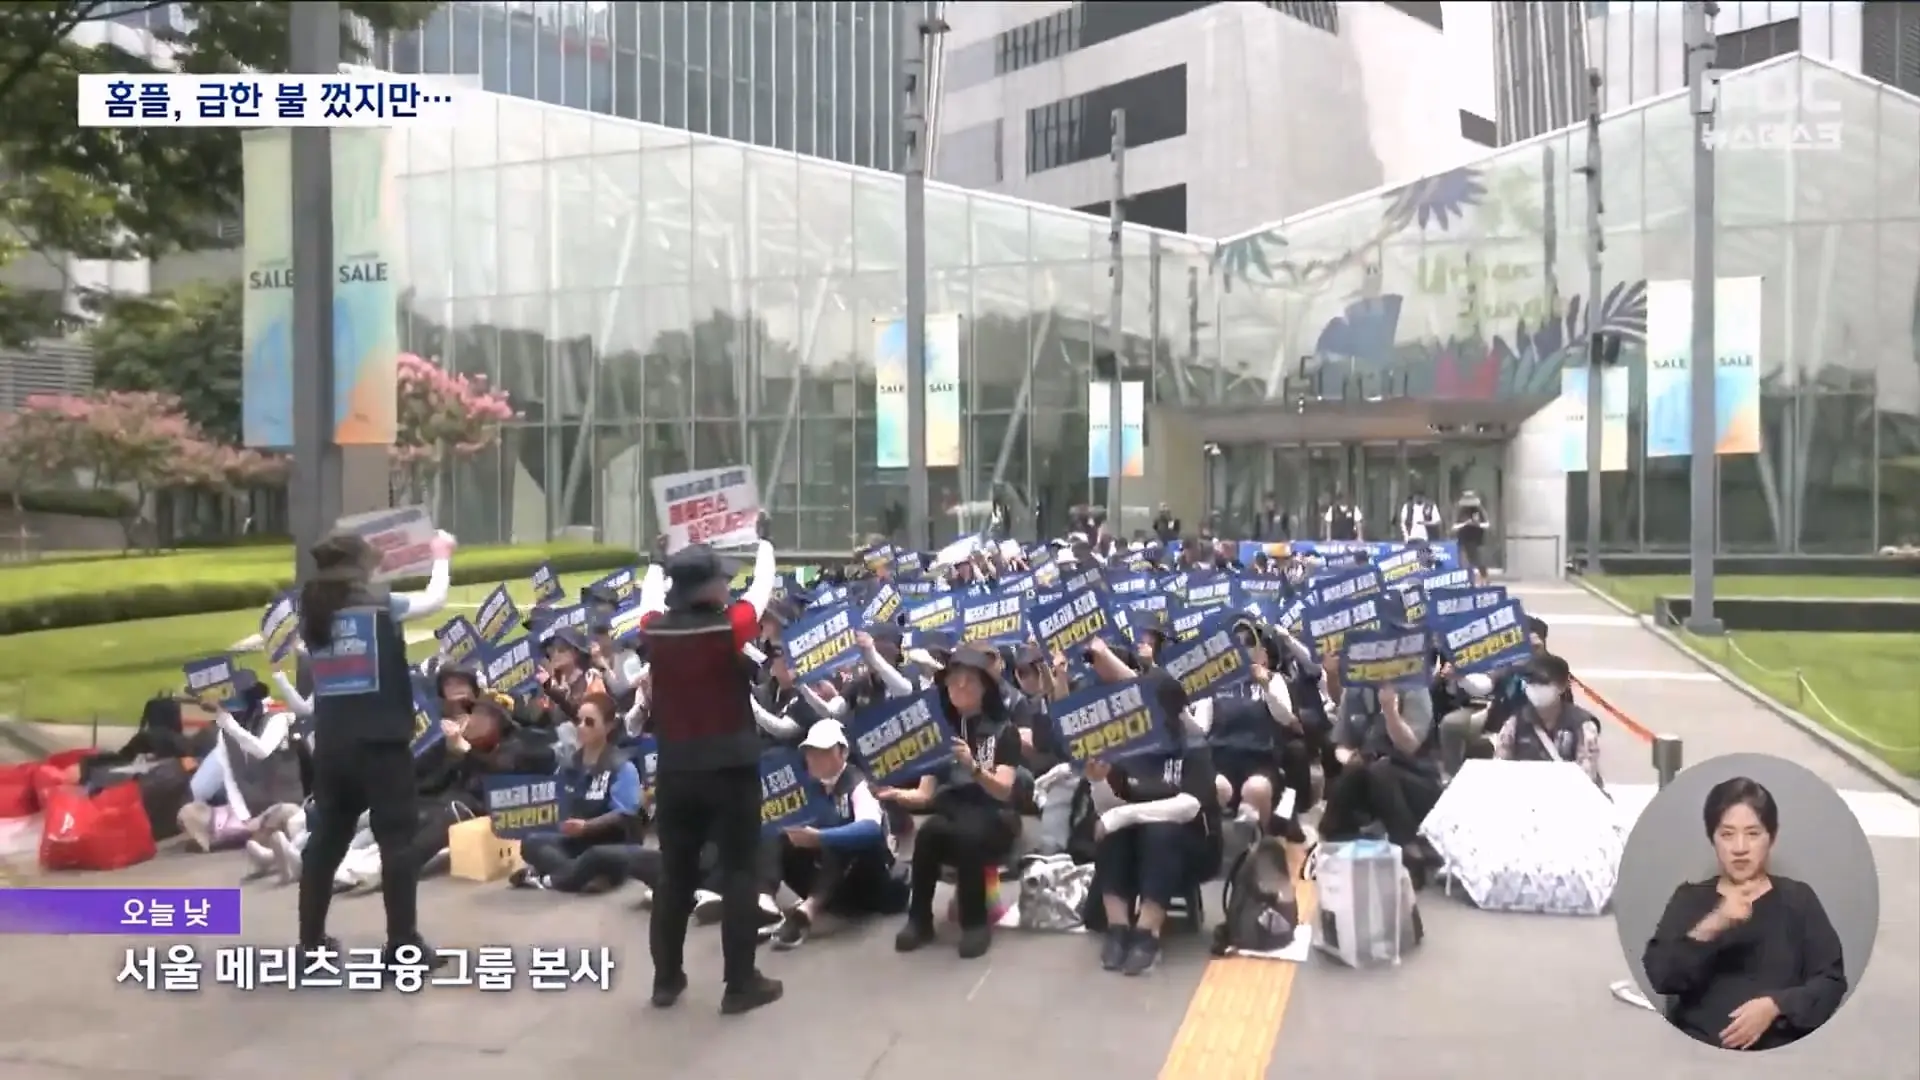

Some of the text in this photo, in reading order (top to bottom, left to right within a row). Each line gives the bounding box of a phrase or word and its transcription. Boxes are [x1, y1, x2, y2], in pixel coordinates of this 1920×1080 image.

[249, 268, 296, 290] SALE
[338, 262, 388, 284] SALE
[1652, 357, 1688, 370] SALE
[1718, 354, 1753, 368] SALE
[880, 383, 905, 395] SALE
[929, 382, 954, 394] SALE
